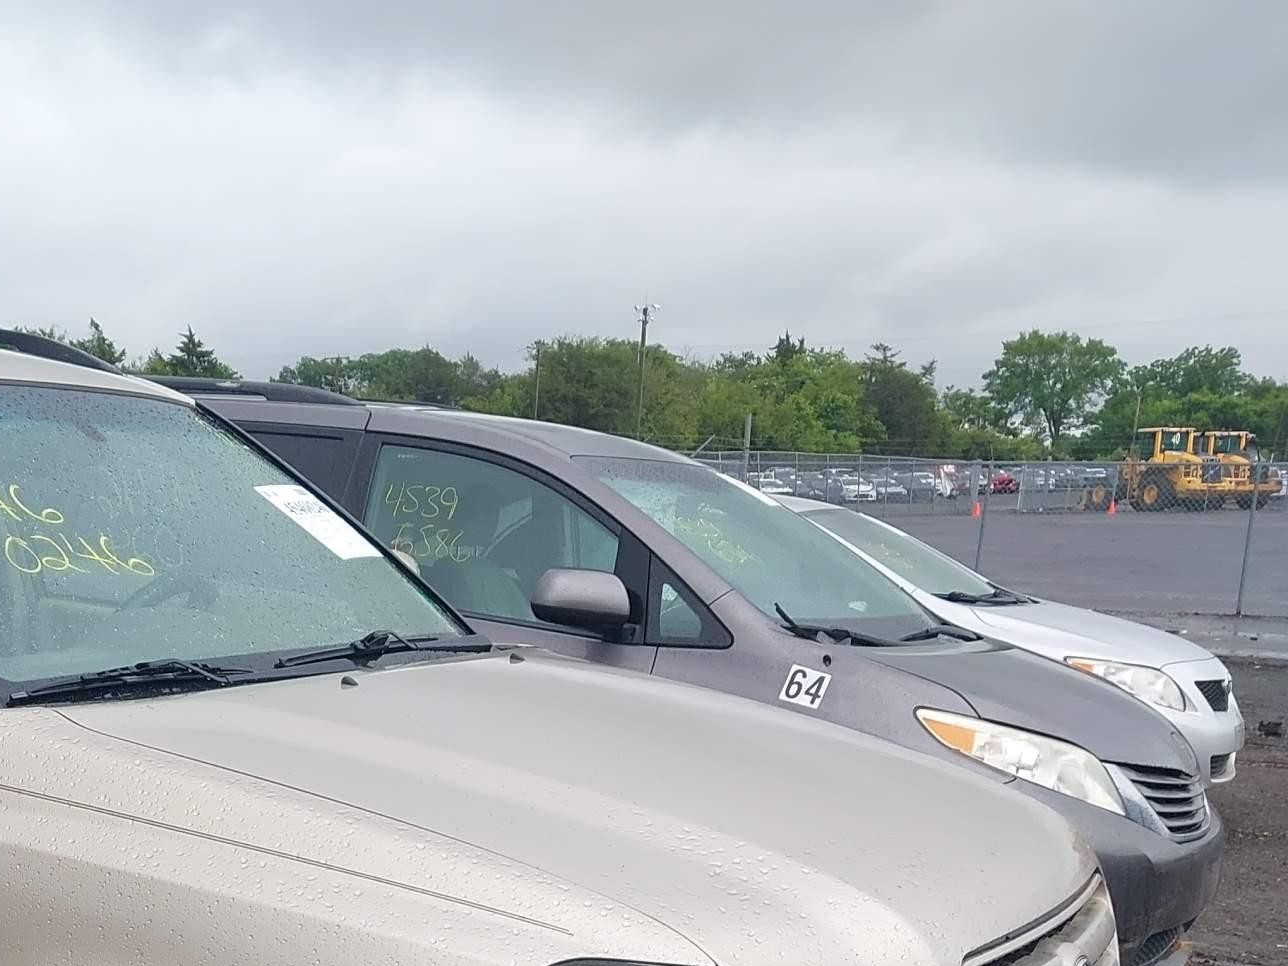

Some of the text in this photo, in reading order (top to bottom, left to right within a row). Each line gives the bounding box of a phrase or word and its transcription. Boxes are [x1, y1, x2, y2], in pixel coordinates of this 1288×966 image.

[385, 481, 459, 520] 4539
[5, 532, 155, 576] 0246
[785, 669, 826, 705] 64
